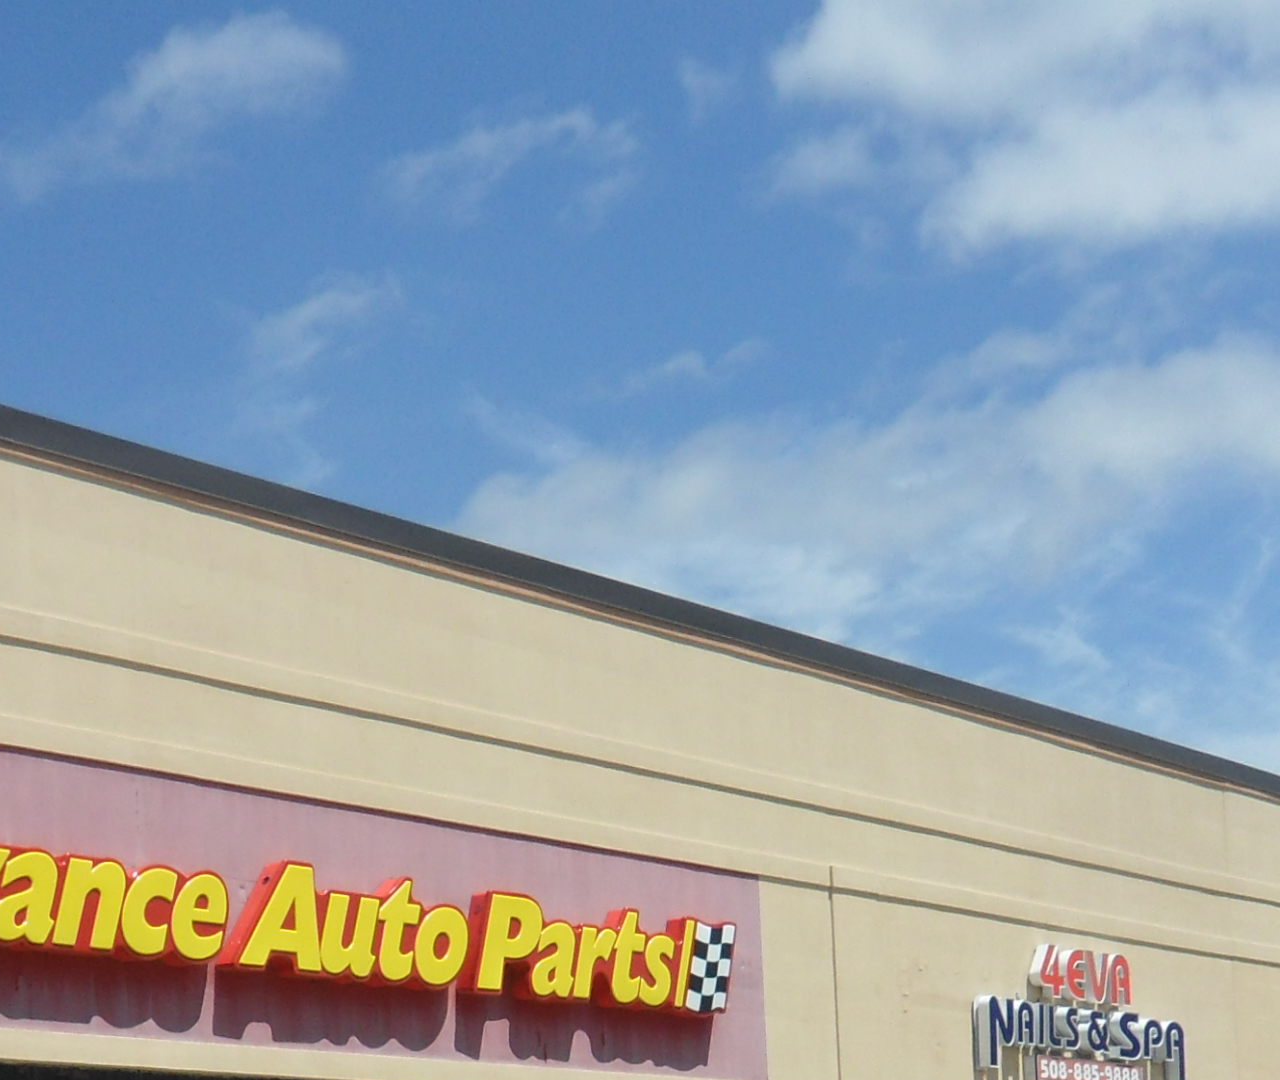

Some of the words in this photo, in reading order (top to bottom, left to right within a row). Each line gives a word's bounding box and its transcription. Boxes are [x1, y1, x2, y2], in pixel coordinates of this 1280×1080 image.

[230, 862, 469, 987] Auto
[472, 892, 673, 1007] Parts
[1036, 944, 1132, 1005] 4EVA
[983, 995, 1080, 1067] NAILS
[1086, 1011, 1110, 1052] &
